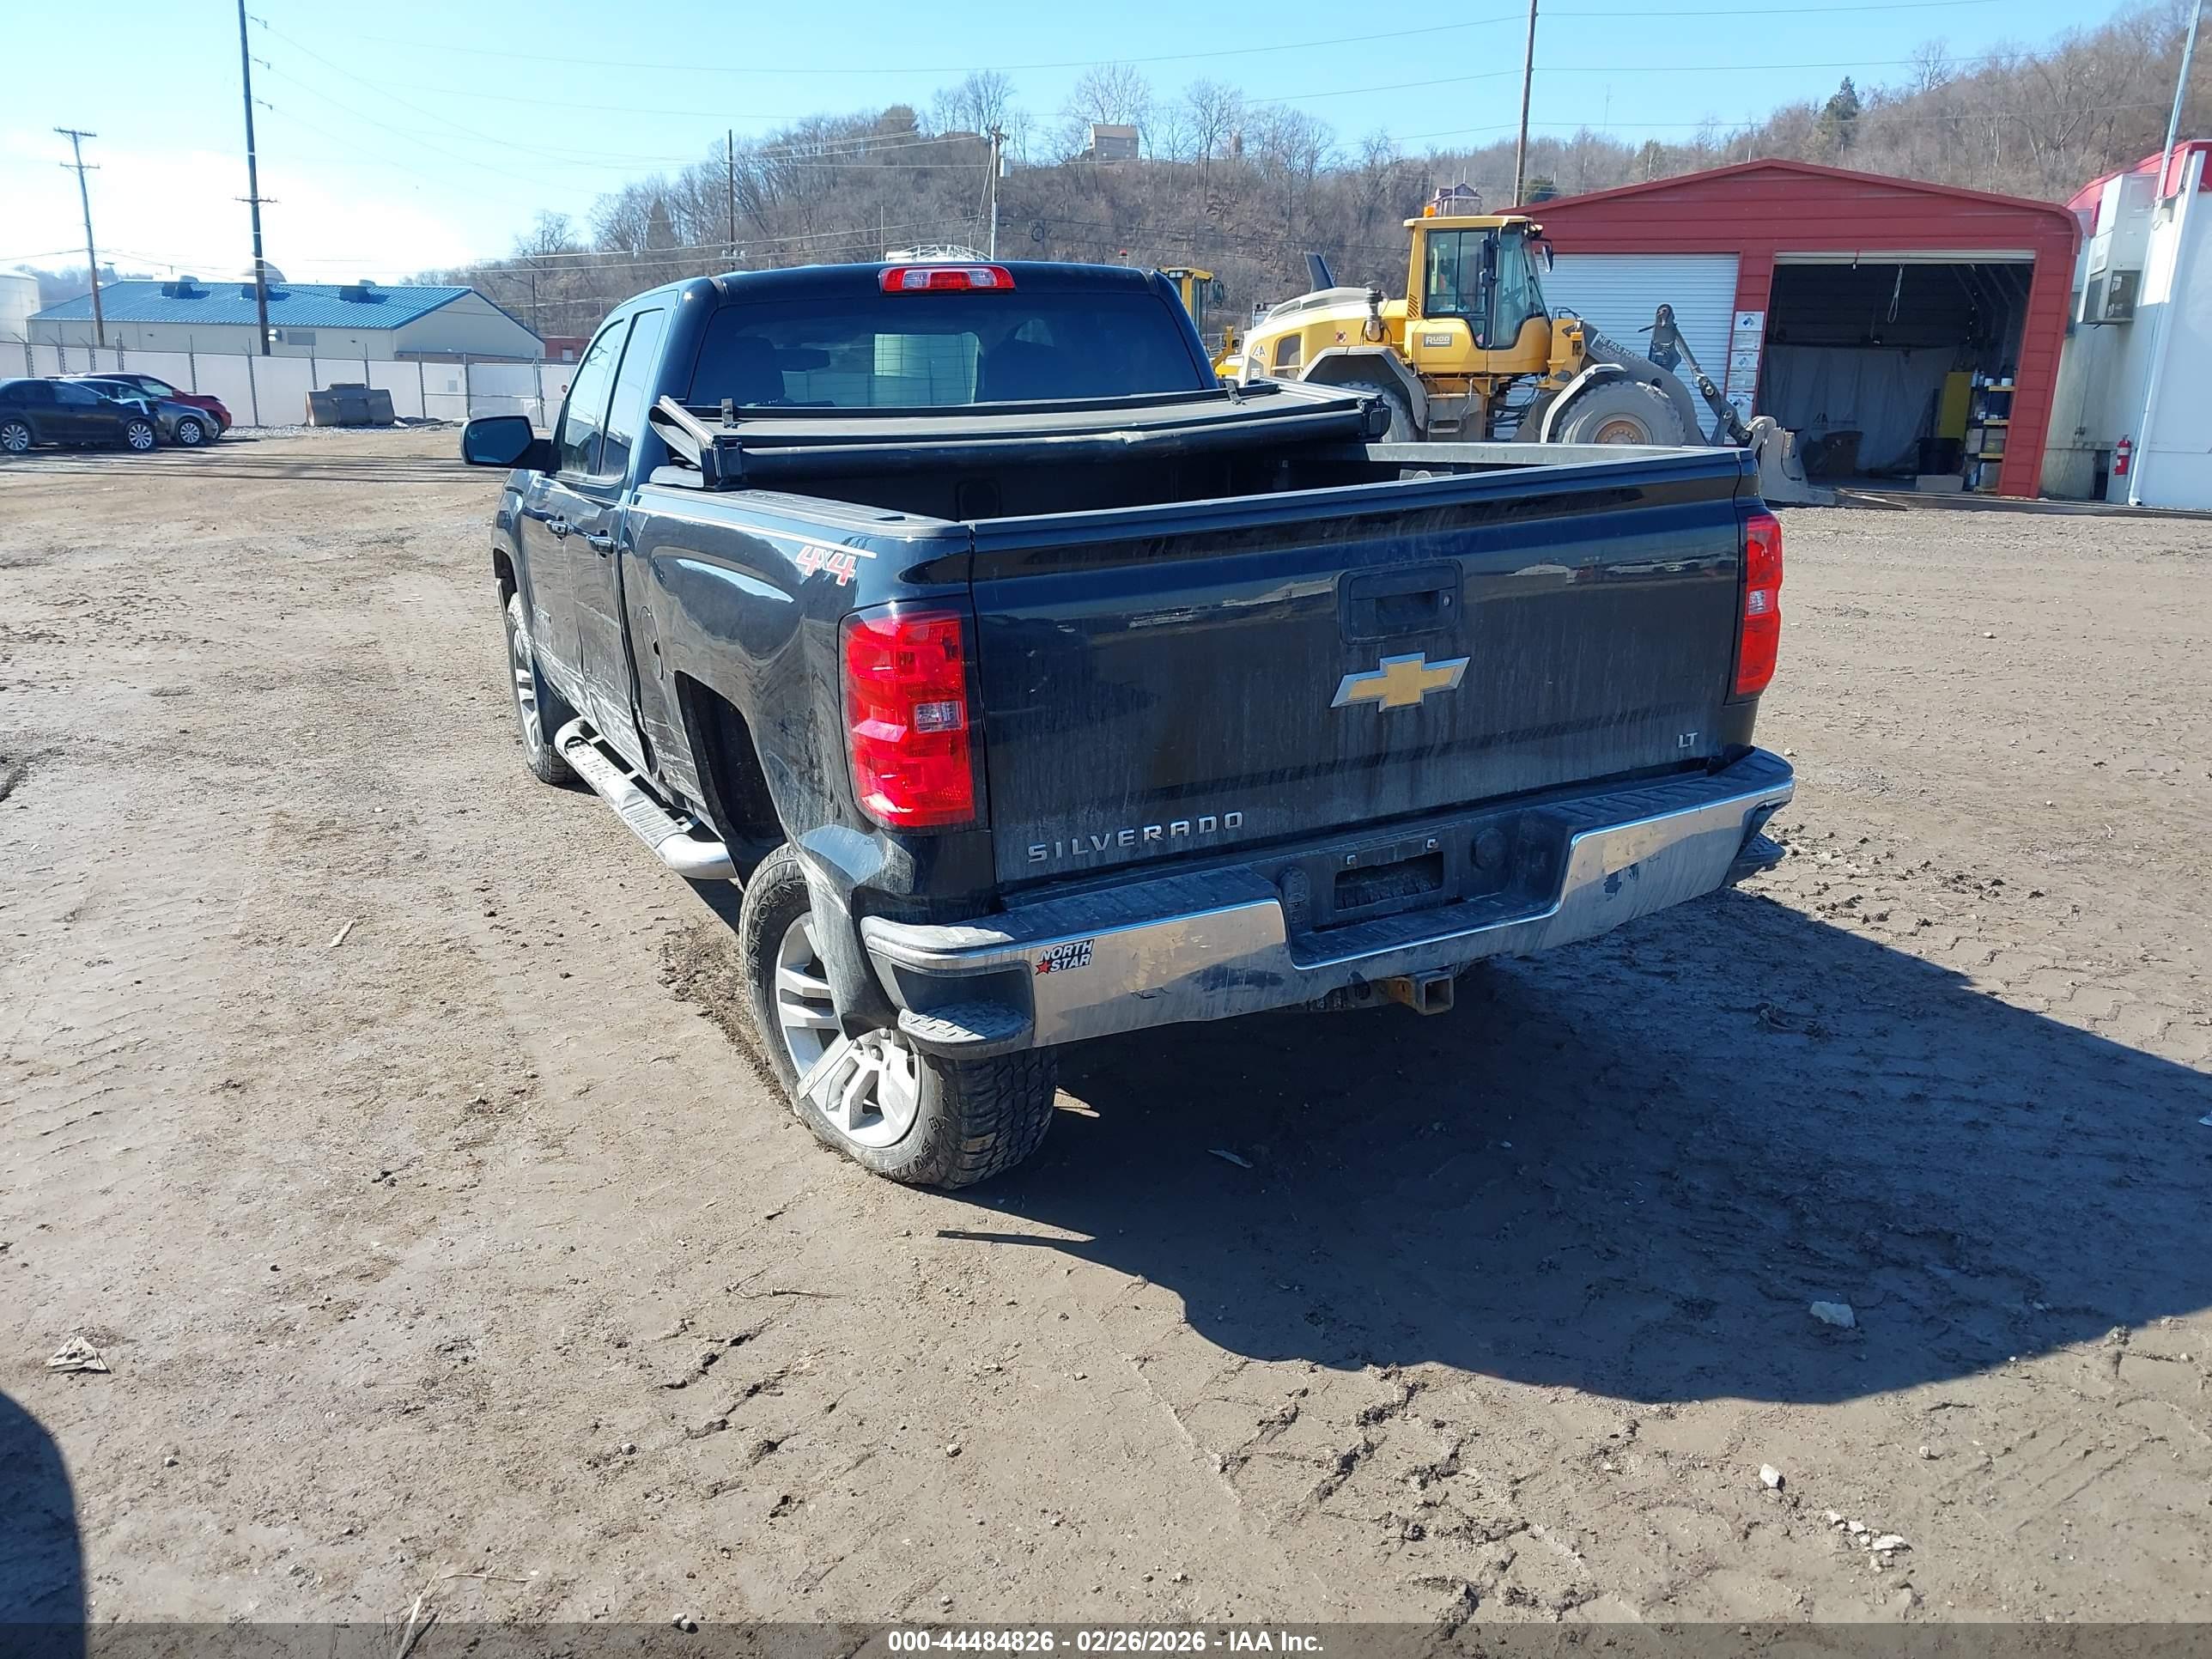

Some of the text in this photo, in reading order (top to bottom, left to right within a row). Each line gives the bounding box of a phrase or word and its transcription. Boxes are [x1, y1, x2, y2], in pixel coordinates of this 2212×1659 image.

[1678, 732, 1698, 748] LT
[1027, 811, 1243, 864] SILVERADO
[1040, 939, 1093, 961] NORTH
[1049, 953, 1091, 972] STAR
